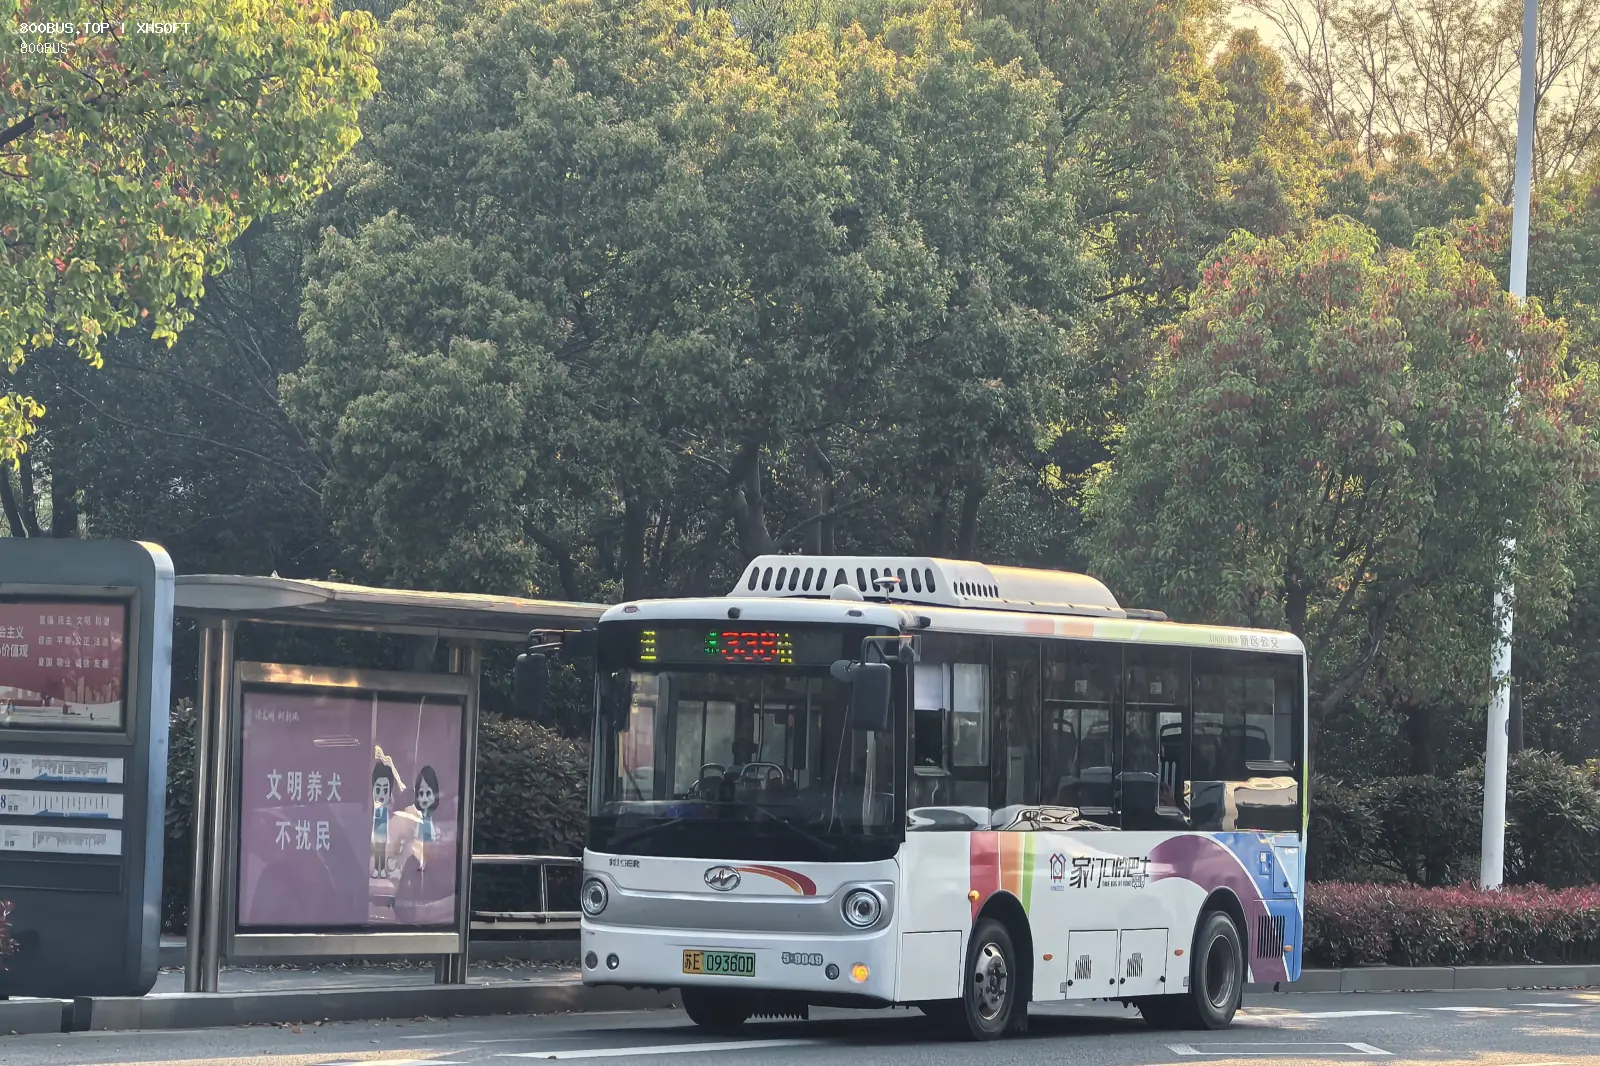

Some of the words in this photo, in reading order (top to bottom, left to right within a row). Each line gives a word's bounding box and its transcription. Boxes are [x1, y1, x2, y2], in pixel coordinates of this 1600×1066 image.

[0, 644, 28, 657] 价值观
[265, 769, 342, 802] 文明养犬
[275, 820, 332, 851] 不扰民
[1069, 856, 1151, 888] 家门口的巴士
